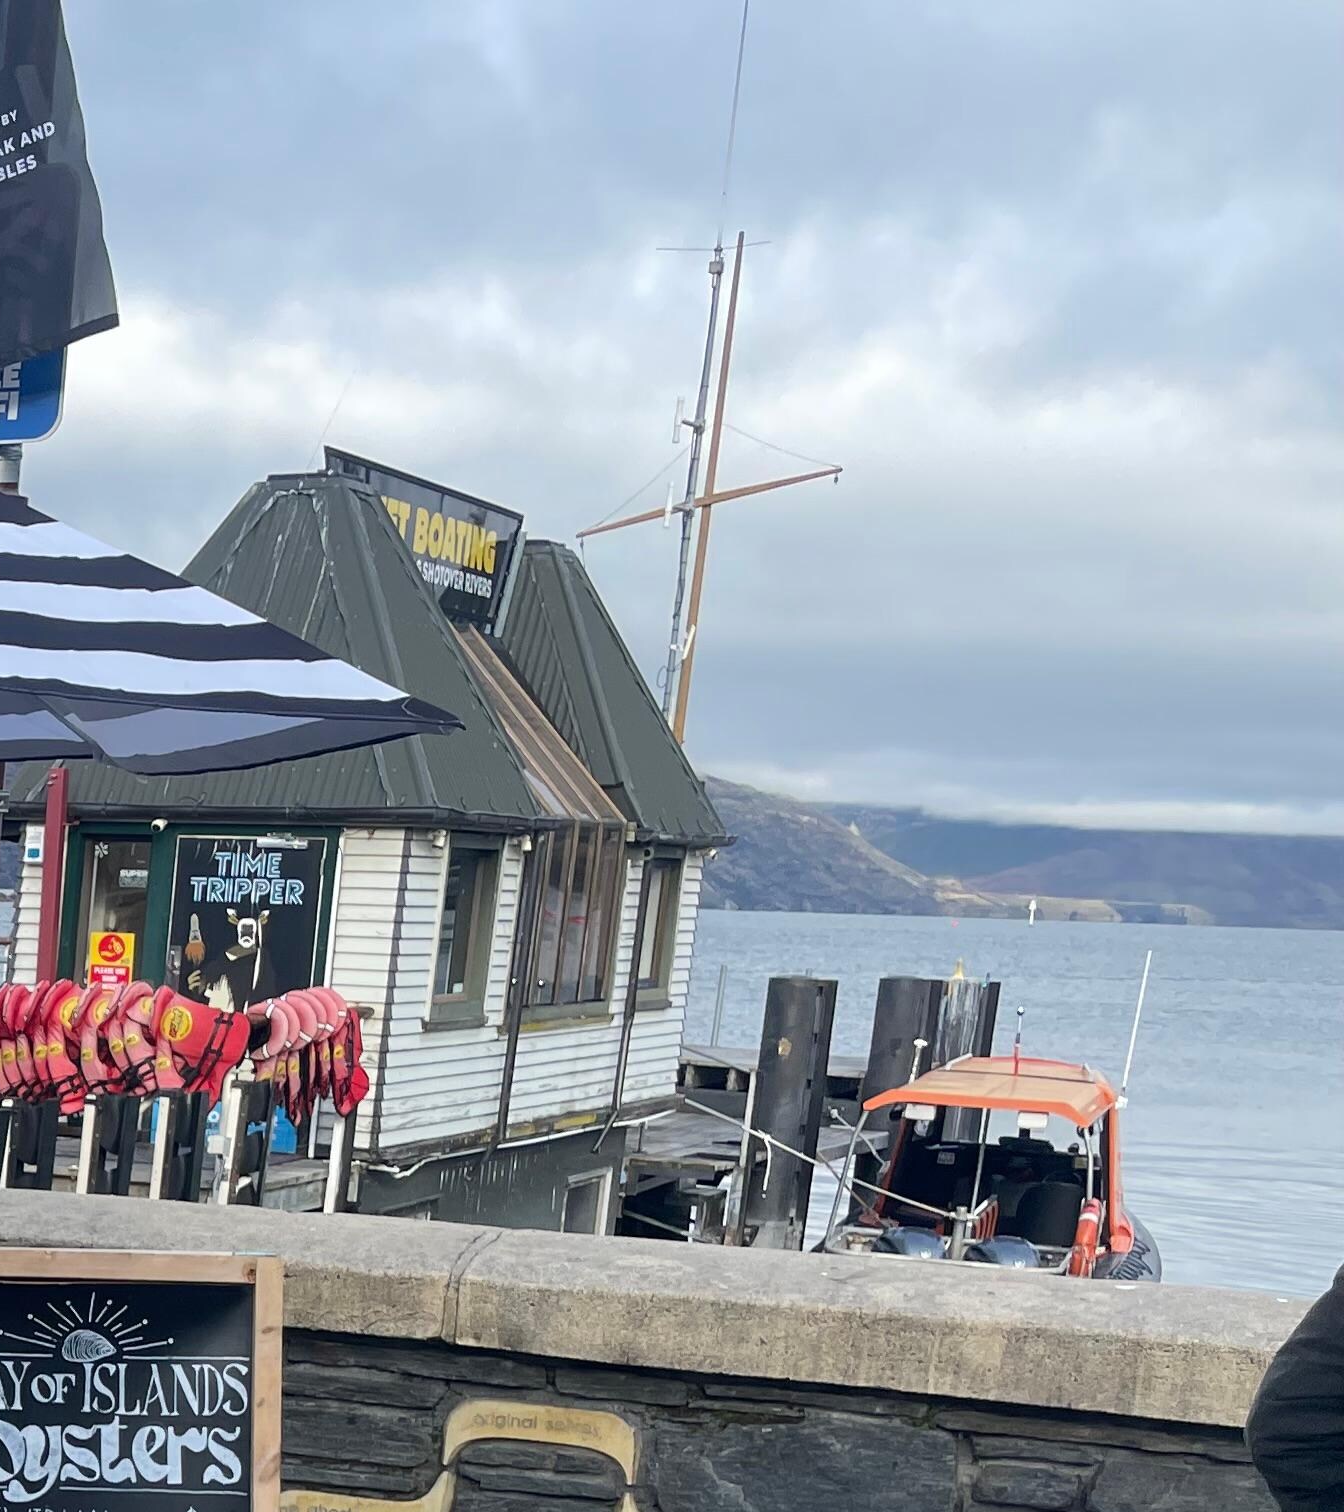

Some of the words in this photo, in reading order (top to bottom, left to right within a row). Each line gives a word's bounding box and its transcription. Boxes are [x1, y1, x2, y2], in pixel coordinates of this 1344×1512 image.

[1, 110, 17, 127] BY
[21, 121, 55, 148] AND
[381, 496, 411, 540] ET
[413, 507, 497, 574] BOATING
[422, 562, 464, 591] SHOTOVER
[465, 572, 492, 598] RIVERS
[215, 852, 282, 878] TIME
[190, 877, 305, 905] TRIPPER
[81, 1363, 250, 1416] ISLANDS
